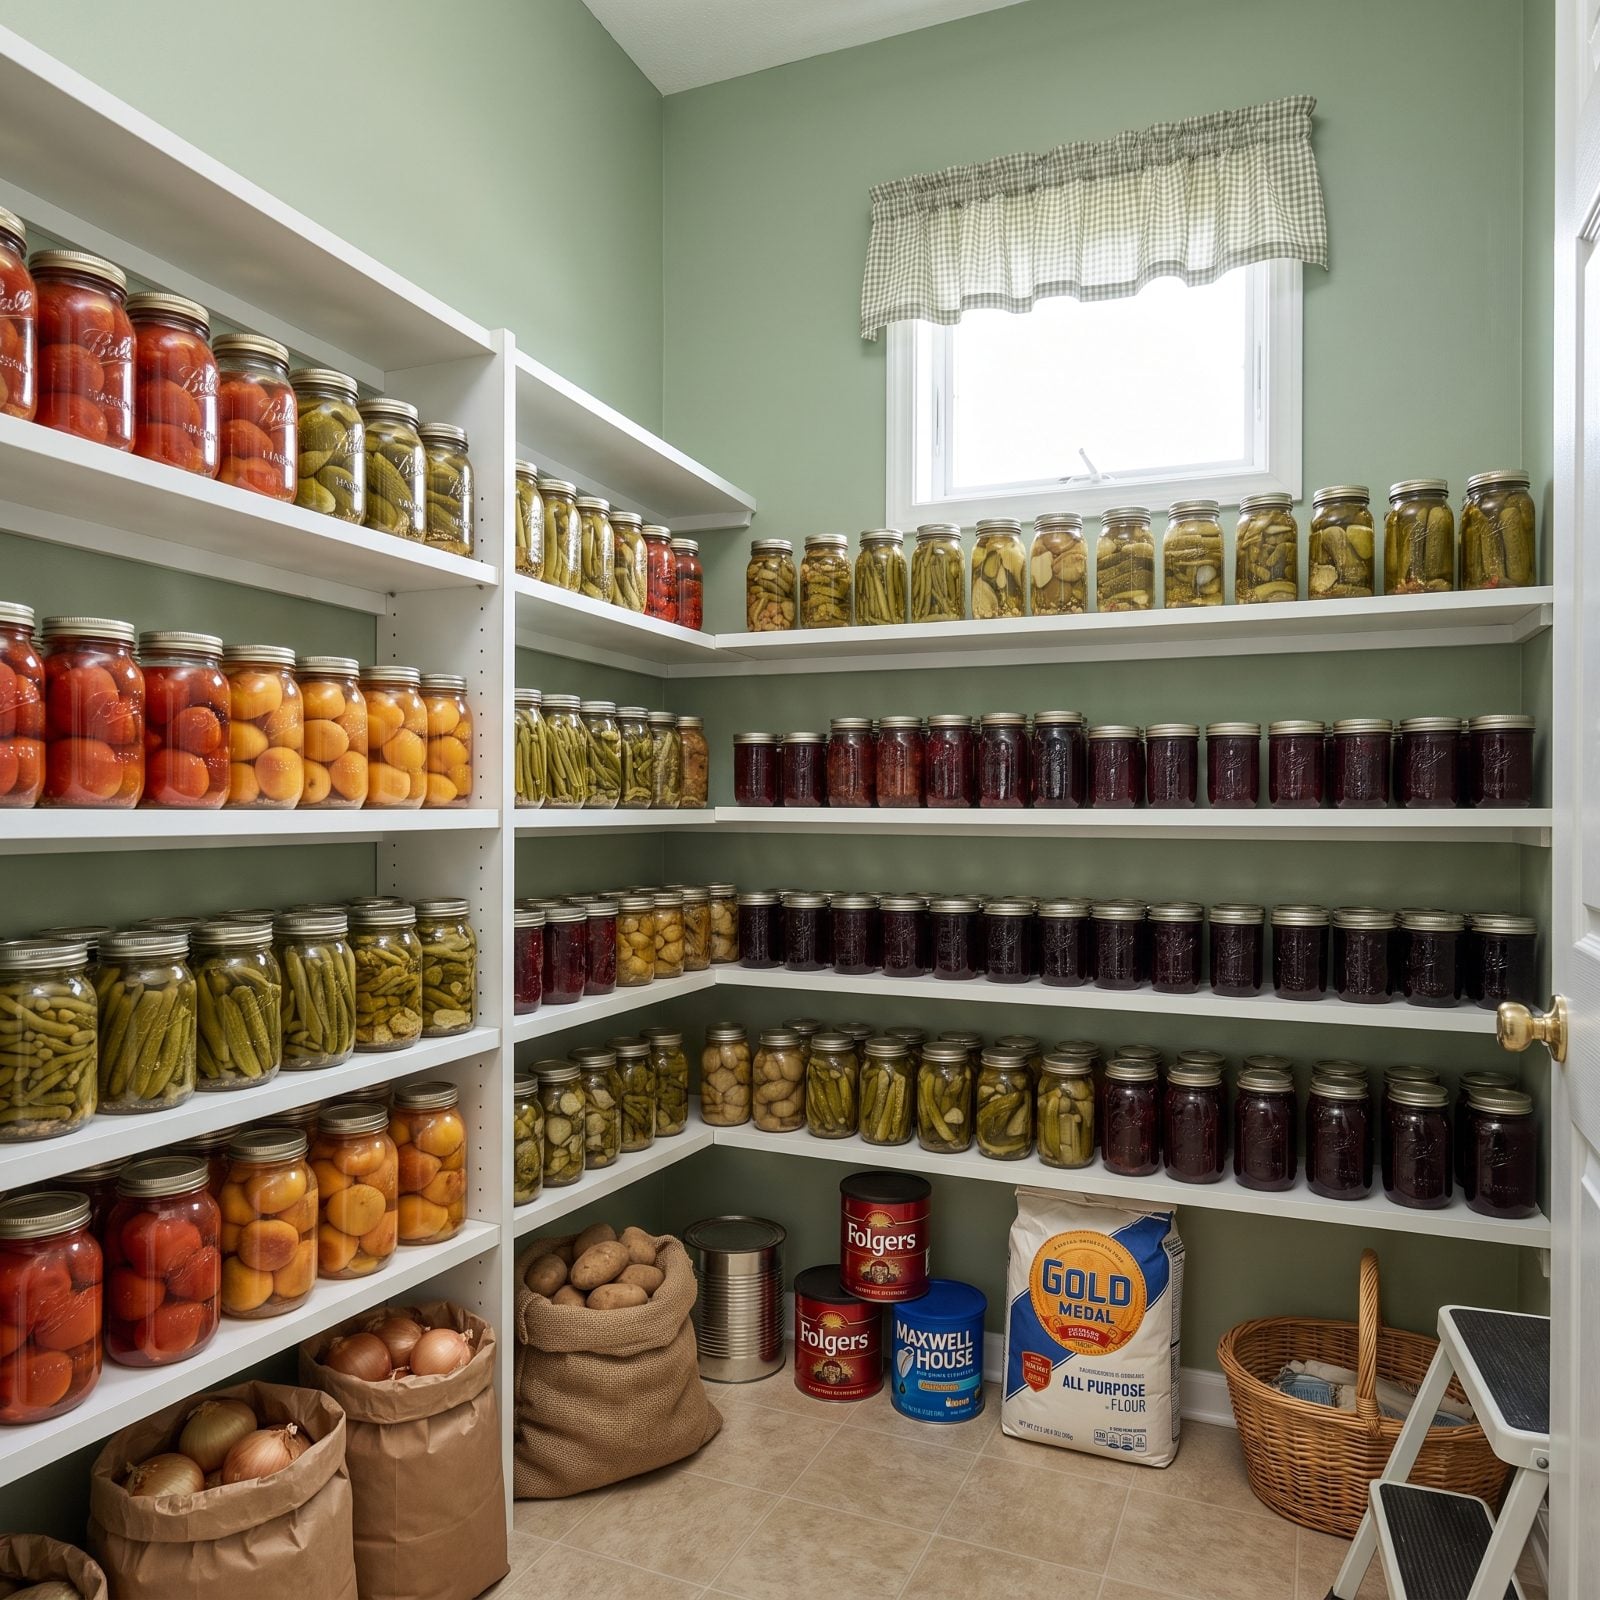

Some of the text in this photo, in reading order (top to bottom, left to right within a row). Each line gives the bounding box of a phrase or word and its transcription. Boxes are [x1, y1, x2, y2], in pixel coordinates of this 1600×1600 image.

[0, 279, 32, 311] all
[848, 1222, 916, 1257] Folgers
[1042, 1258, 1133, 1307] GOLD
[1059, 1301, 1115, 1325] MEDAL
[800, 1320, 868, 1356] Folgers
[896, 1320, 973, 1350] MAXWELL
[916, 1348, 973, 1370] HOUSE
[1062, 1375, 1084, 1391] ALL
[1087, 1379, 1146, 1397] PURPOSE
[1111, 1398, 1146, 1413] FLOUR
